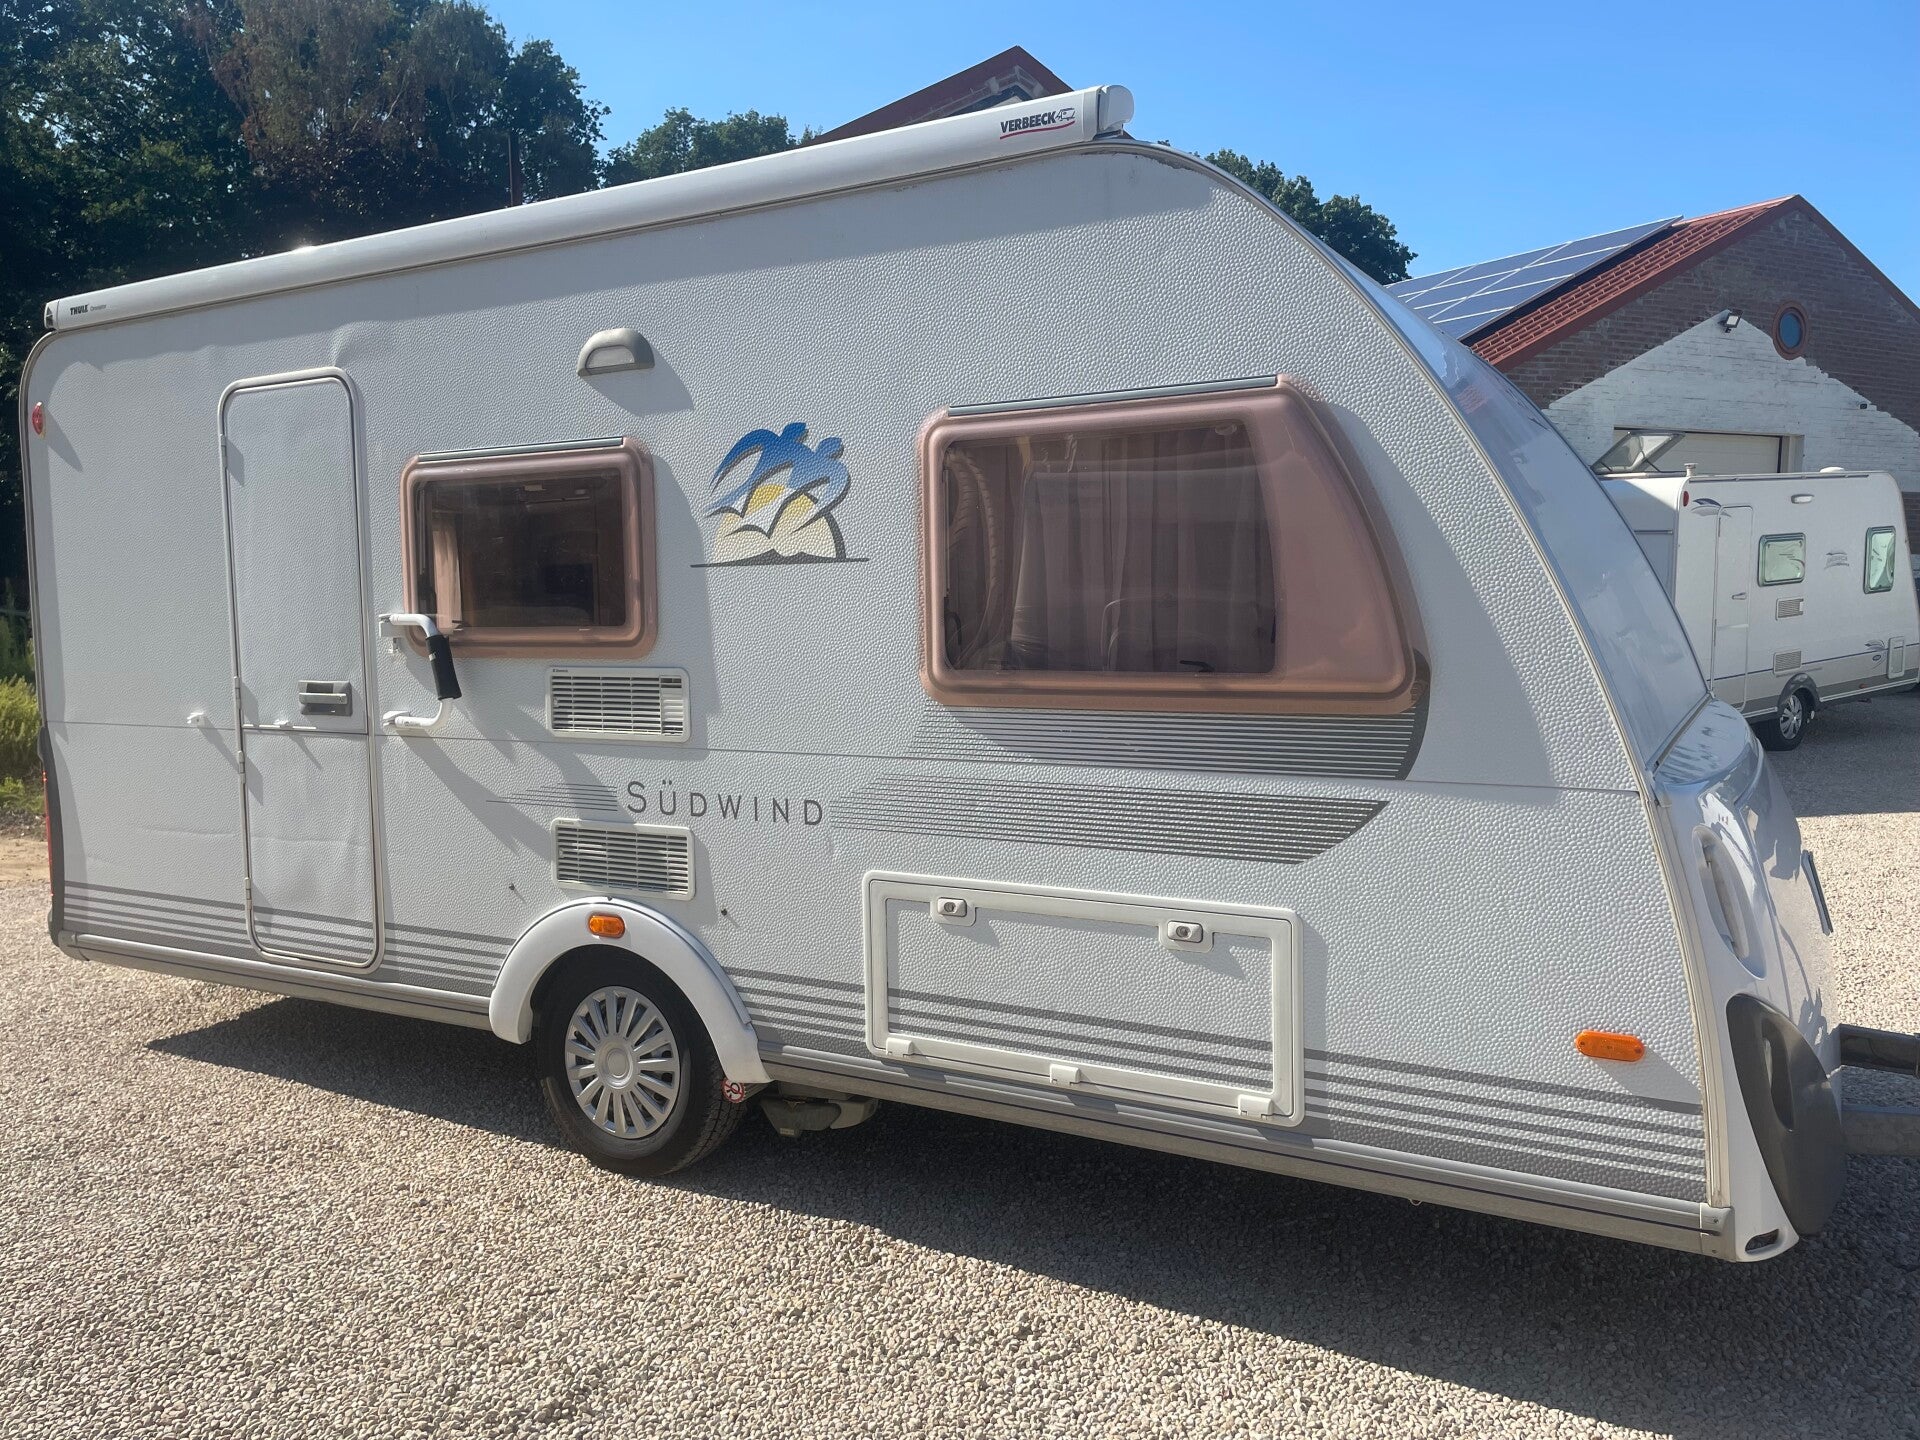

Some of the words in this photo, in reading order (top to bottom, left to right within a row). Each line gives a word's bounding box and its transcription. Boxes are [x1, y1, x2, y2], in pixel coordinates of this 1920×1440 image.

[1000, 111, 1056, 133] VERBEECK
[70, 304, 89, 315] THULE
[627, 779, 823, 825] SÜDWIND
